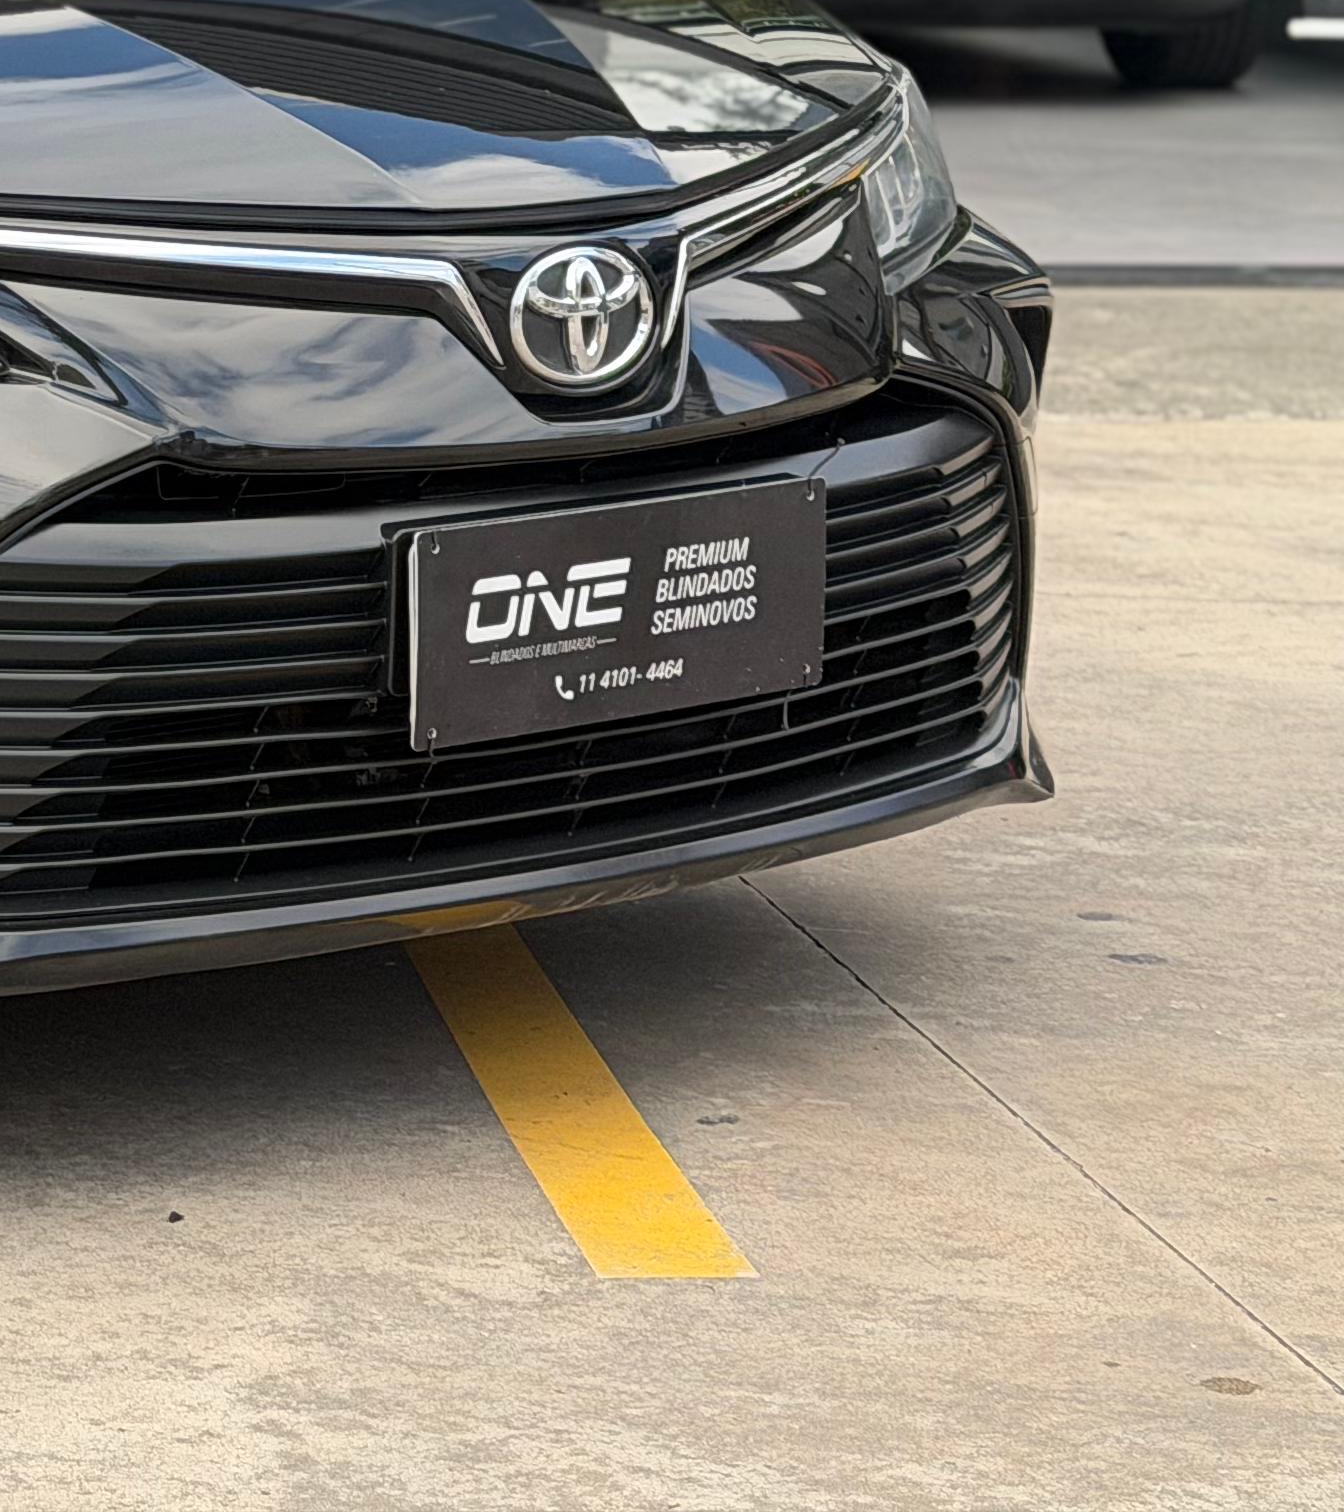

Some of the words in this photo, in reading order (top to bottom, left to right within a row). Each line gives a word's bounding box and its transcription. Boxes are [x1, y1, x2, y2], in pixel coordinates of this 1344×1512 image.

[664, 536, 751, 573] PREMIUM
[465, 557, 632, 644] ONE
[655, 565, 757, 603] BLINDADOS
[650, 595, 758, 635] SEMINOVOS
[579, 672, 596, 694] 11
[646, 658, 684, 683] 4464
